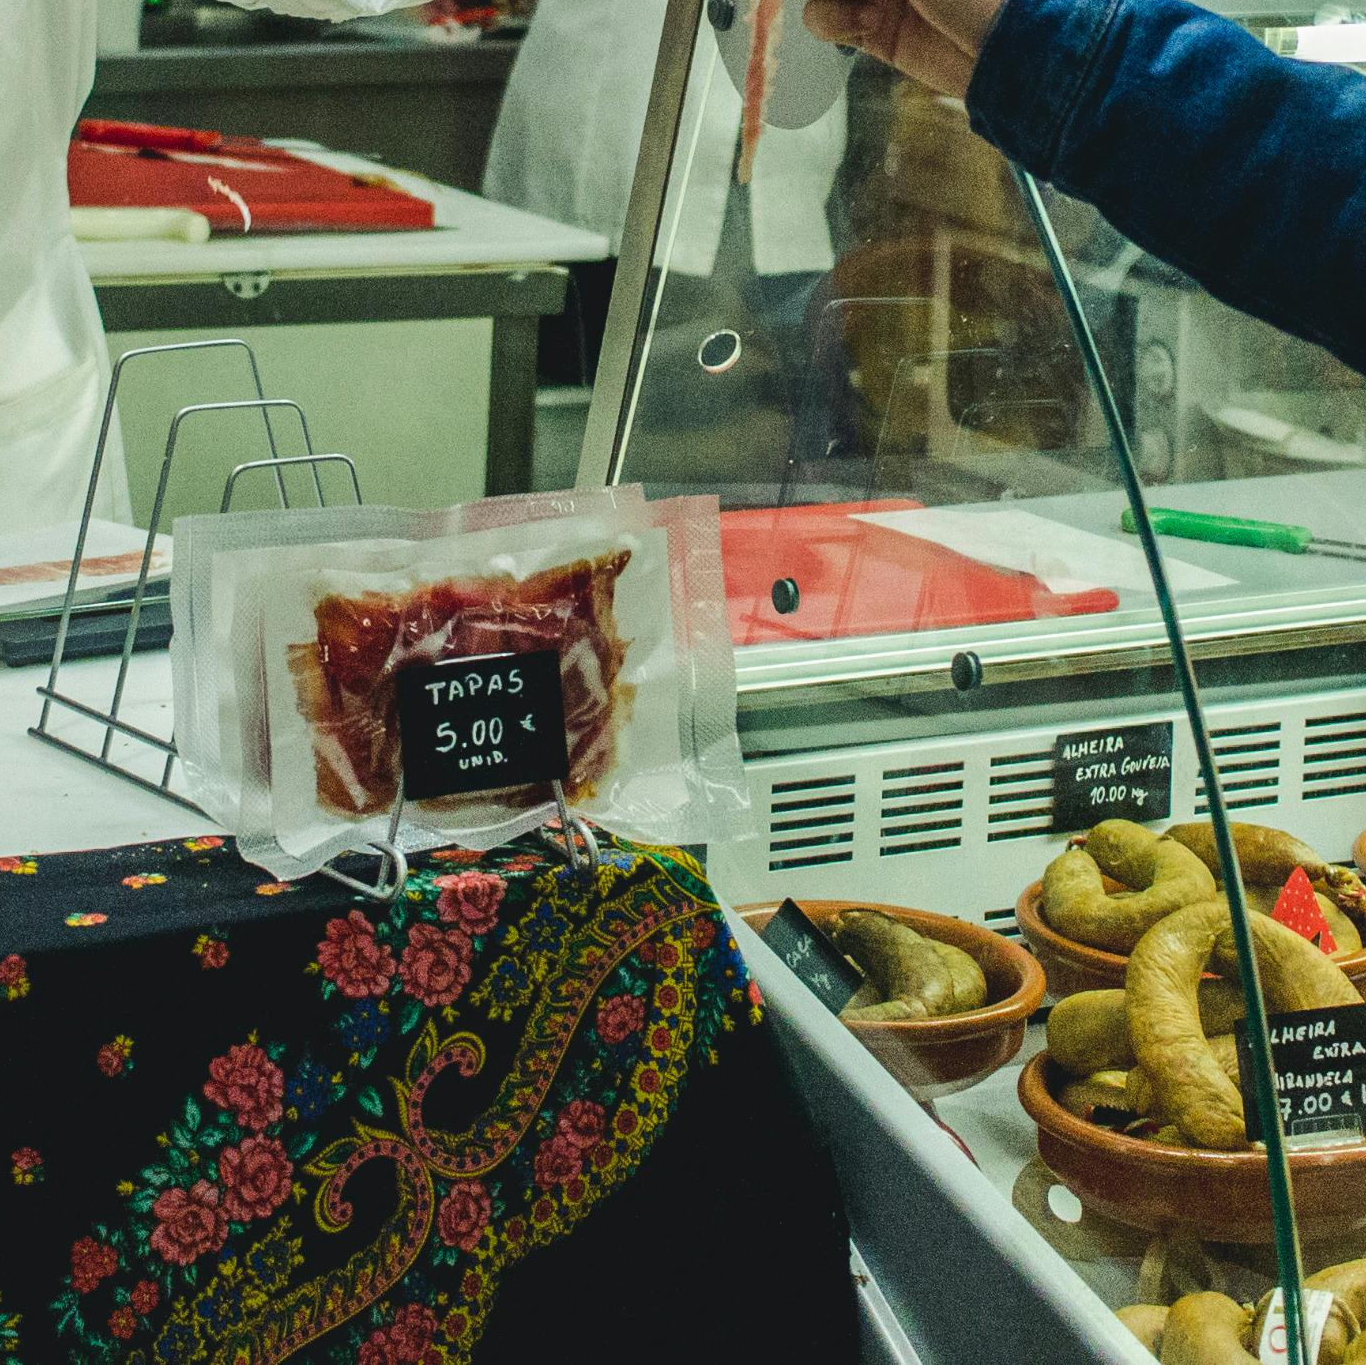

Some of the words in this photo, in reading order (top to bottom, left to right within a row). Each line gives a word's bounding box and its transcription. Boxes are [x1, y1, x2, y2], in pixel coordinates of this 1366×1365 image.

[424, 669, 524, 705] TAPAS
[435, 717, 504, 753] 5.00
[520, 714, 536, 731] €
[1062, 736, 1124, 760] ALHEIRA
[1076, 762, 1117, 782] EXTRA
[1121, 754, 1171, 775] GOUVEIA
[1090, 785, 1127, 805] 10.00
[1267, 1019, 1336, 1045] LHEIRA
[1313, 1041, 1366, 1060] EXTRA
[1279, 1092, 1333, 1122] 7.00
